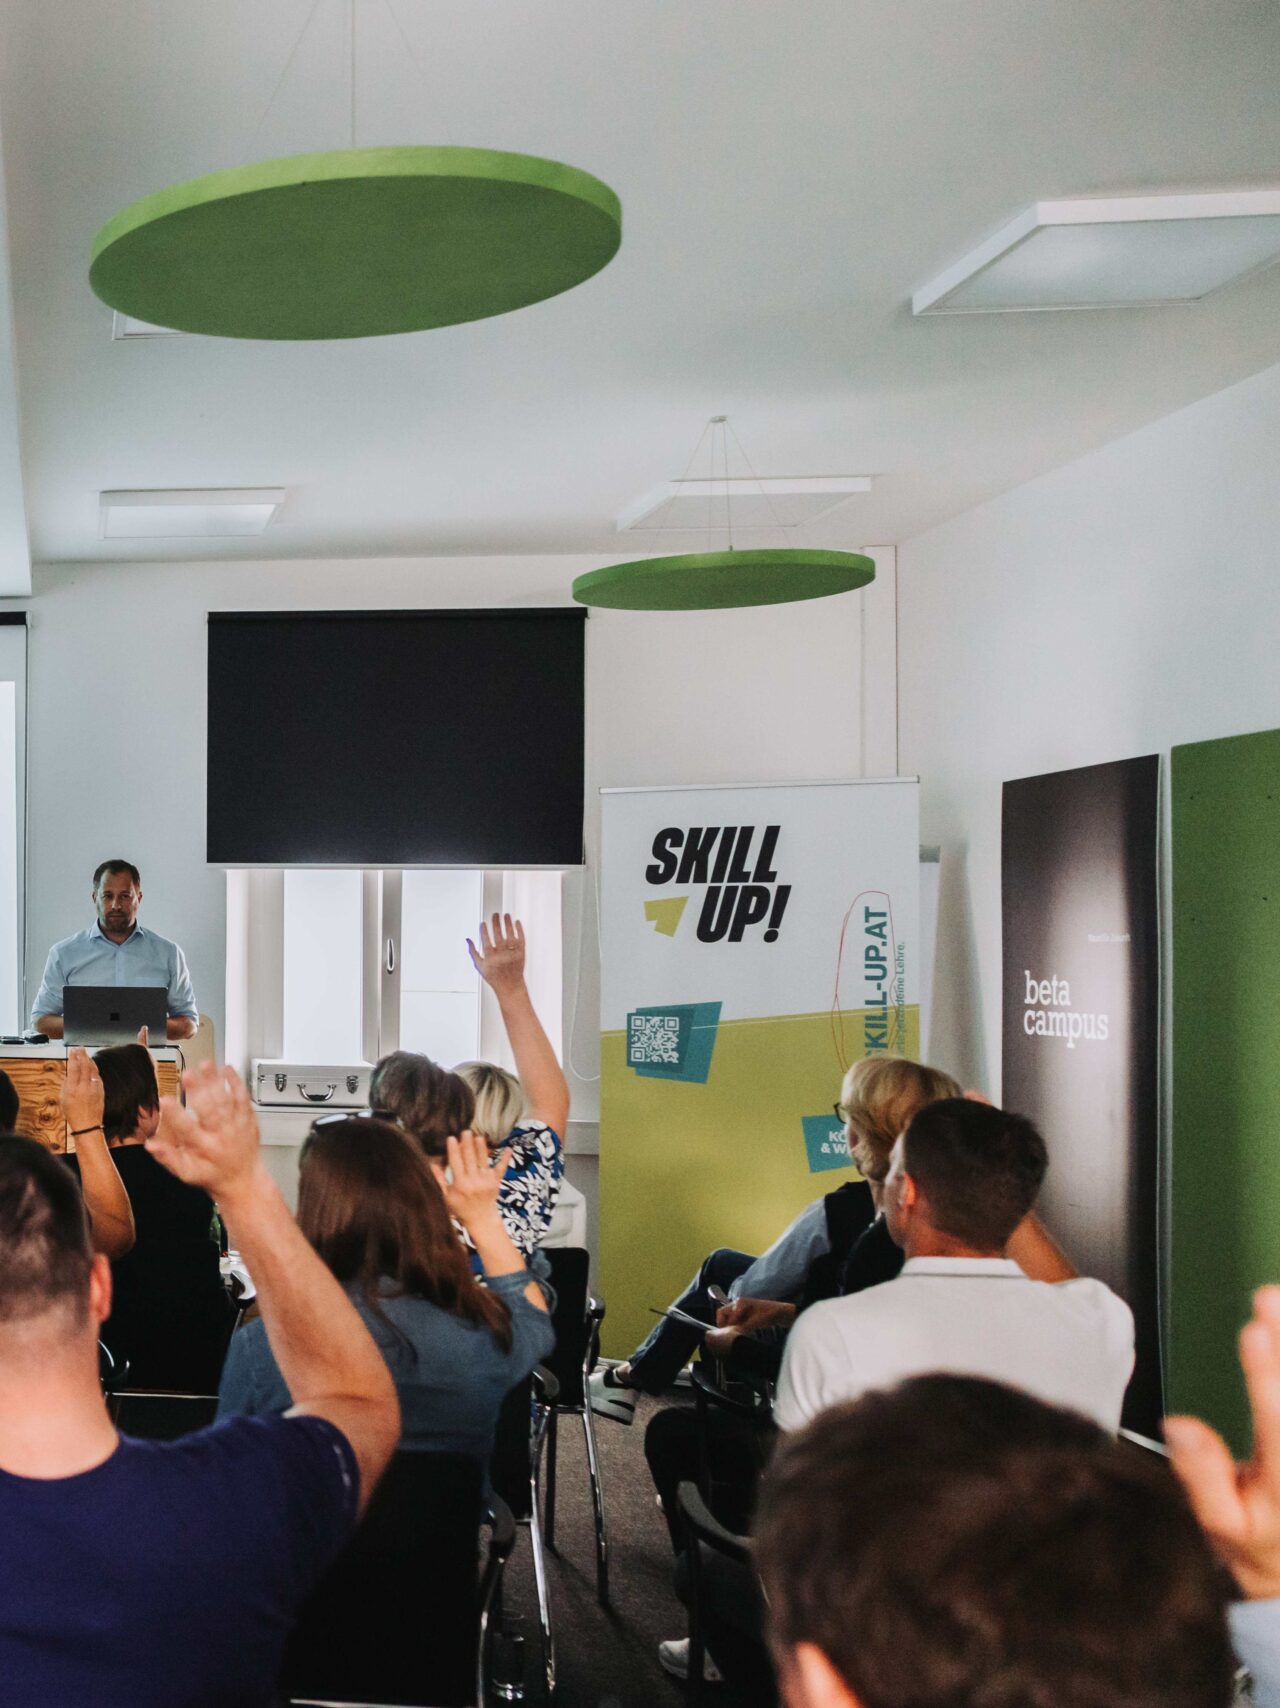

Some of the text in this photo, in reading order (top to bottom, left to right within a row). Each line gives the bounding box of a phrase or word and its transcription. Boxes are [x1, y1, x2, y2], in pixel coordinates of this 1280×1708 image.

[645, 825, 781, 885] SKILL
[696, 884, 792, 944] UP!
[896, 942, 905, 974] Lehre.
[896, 976, 905, 1005] deine
[1024, 970, 1071, 1006] beta
[1023, 1009, 1109, 1048] campus
[821, 1142, 831, 1153] &
